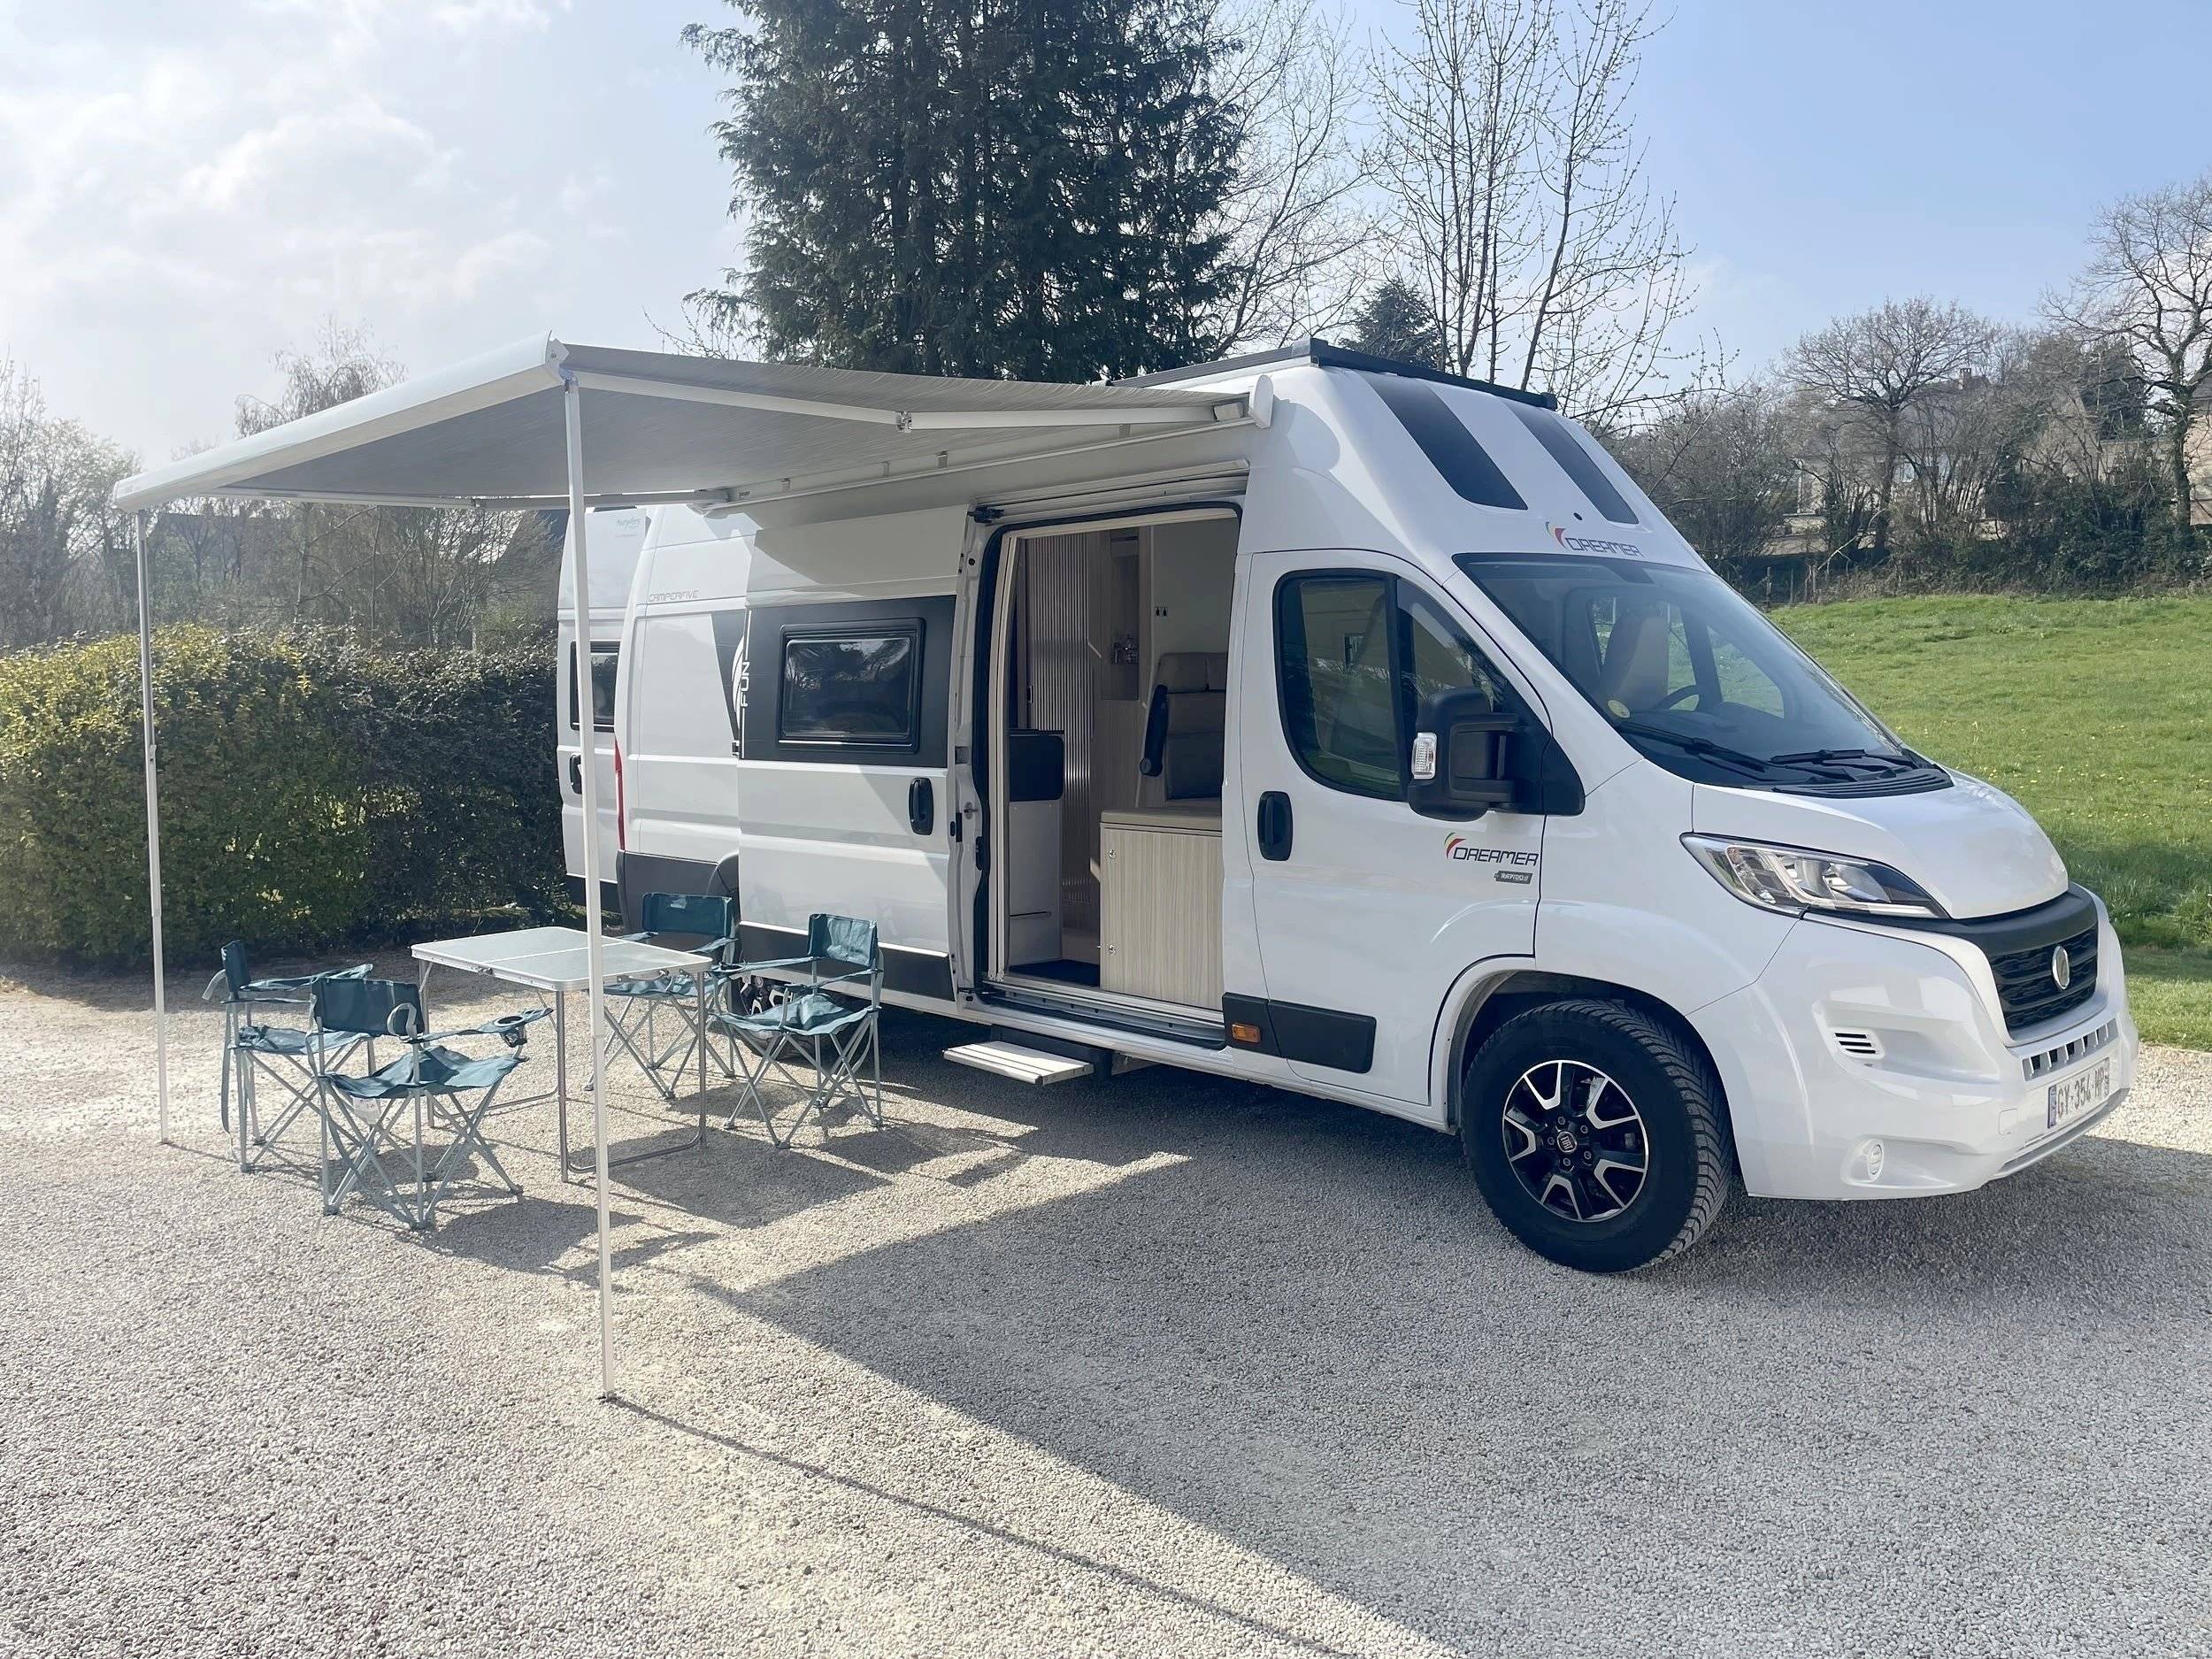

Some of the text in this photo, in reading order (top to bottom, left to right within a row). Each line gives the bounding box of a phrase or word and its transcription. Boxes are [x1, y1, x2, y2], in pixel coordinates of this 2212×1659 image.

[1564, 537, 1644, 557] DREAMER
[741, 662, 749, 707] FUN
[1453, 847, 1539, 866] DREAMER
[1560, 1135, 1573, 1150] FIAT
